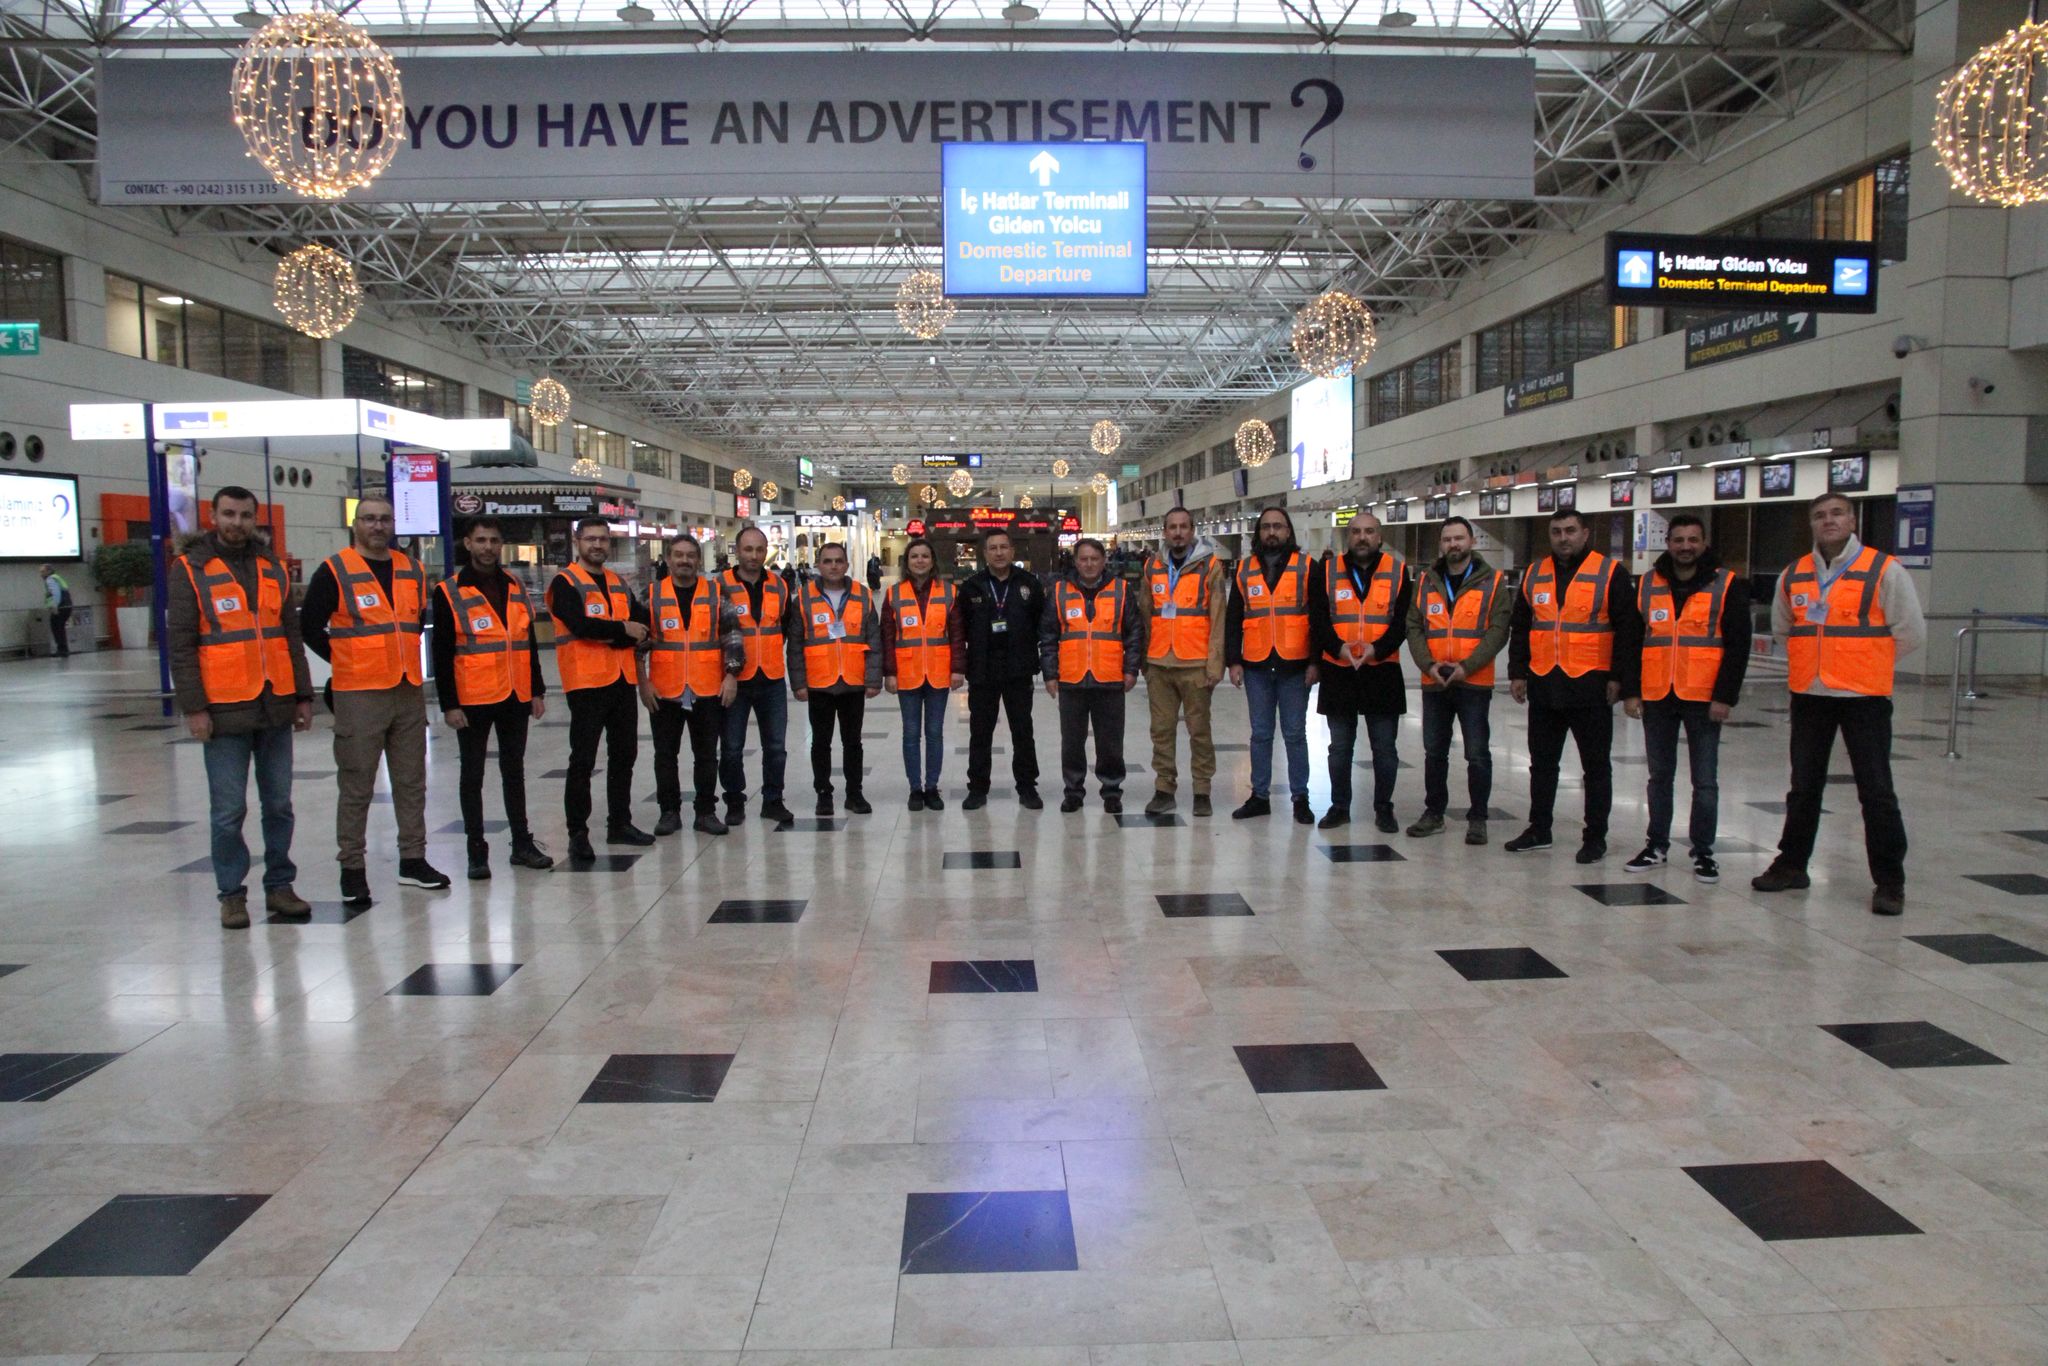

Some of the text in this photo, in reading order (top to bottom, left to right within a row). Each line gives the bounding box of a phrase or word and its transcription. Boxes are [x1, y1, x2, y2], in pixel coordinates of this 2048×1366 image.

[302, 105, 384, 150] DO
[404, 103, 518, 150] YOU
[538, 101, 689, 148] HAVE
[710, 101, 789, 145] AN
[807, 99, 1271, 145] ADVERTISEMENT
[124, 183, 169, 195] CONTACT:
[172, 184, 194, 195] +90
[196, 183, 224, 196] (242)
[226, 184, 247, 195] 315
[258, 184, 279, 195] 315
[960, 188, 1130, 215] İç Hatlar Terminali
[988, 215, 1102, 234] Giden Yolcu
[959, 240, 1132, 259] Domestic Terminal
[1658, 251, 1808, 275] İç Hatlar Giden Yolcu
[1000, 265, 1092, 286] Departure
[1658, 277, 1828, 295] Domestic Terminal Departure
[1690, 311, 1779, 347] DIŞ HAT KAPILAR
[1690, 329, 1780, 363] INTERNATIONAL GATES
[408, 465, 434, 473] CASH
[800, 515, 842, 527] DESA
